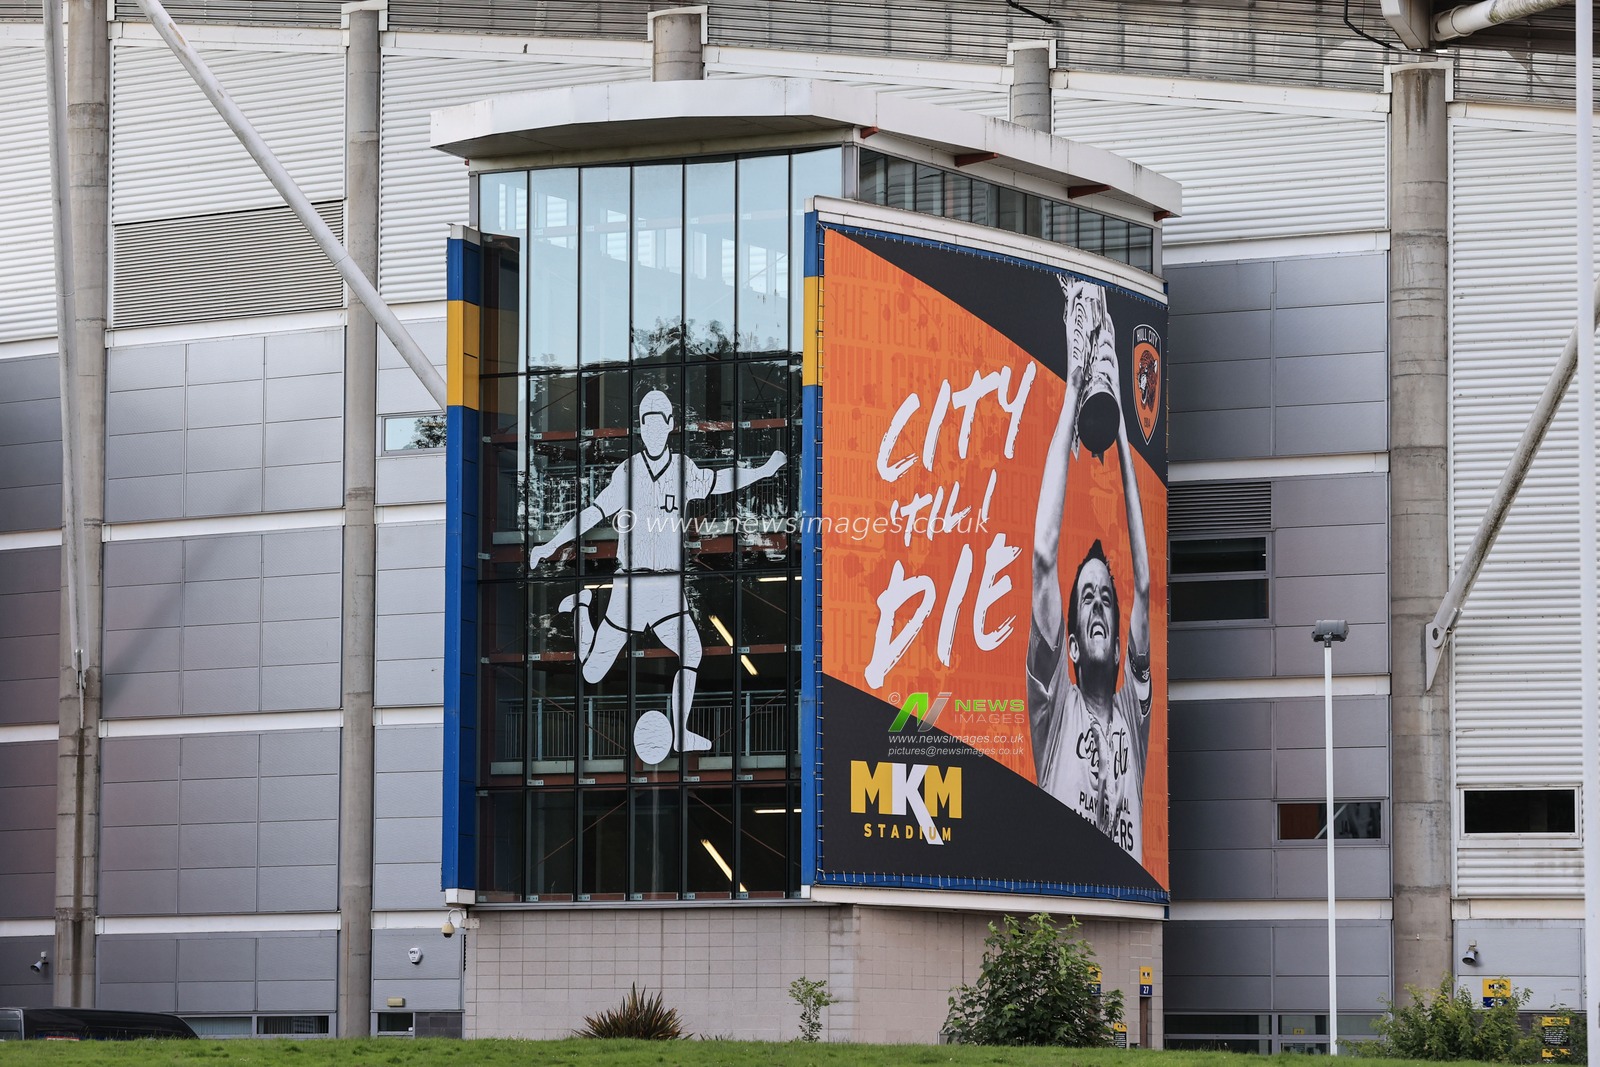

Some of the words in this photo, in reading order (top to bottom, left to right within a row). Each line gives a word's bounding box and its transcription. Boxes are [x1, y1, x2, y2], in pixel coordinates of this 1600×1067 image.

[877, 361, 1036, 482] CITY
[982, 469, 997, 522] I
[864, 533, 1023, 689] DIE
[850, 760, 962, 845] MKM
[864, 823, 951, 842] STADIUM
[1143, 985, 1150, 994] 27
